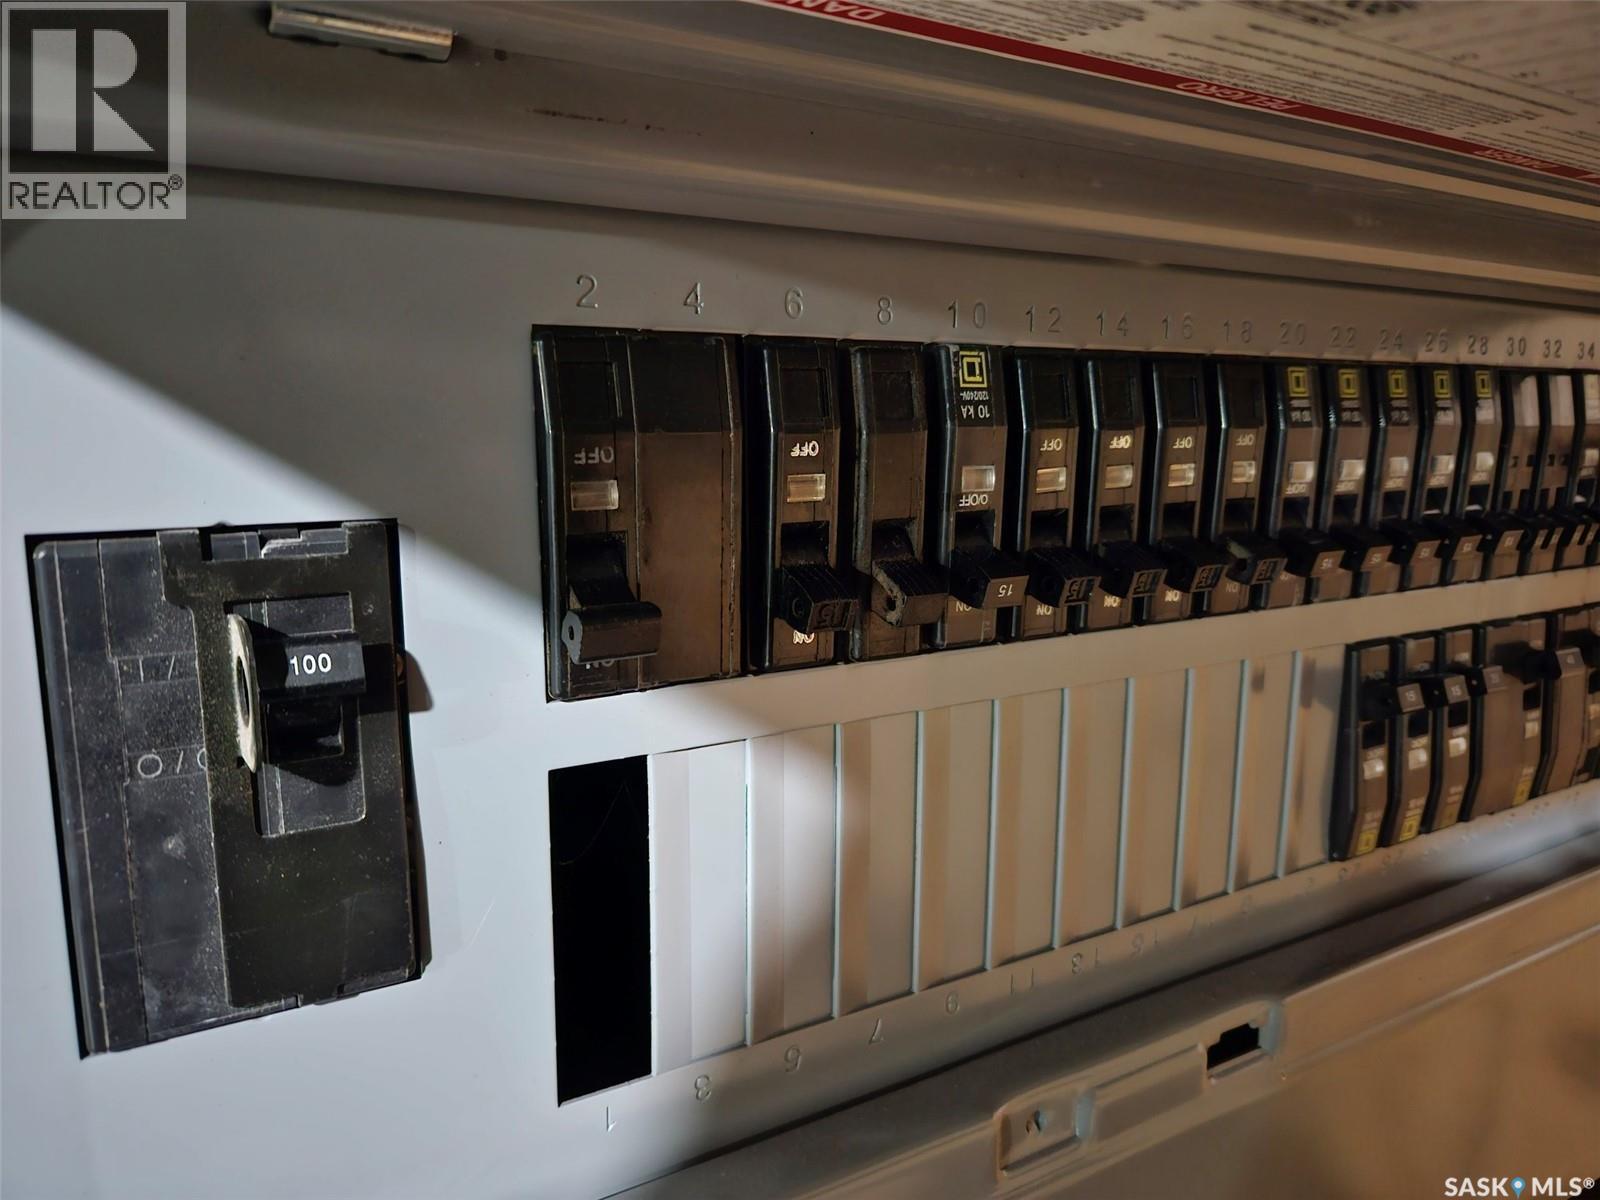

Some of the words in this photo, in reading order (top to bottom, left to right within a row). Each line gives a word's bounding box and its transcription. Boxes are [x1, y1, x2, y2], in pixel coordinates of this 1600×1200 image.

[1176, 81, 1302, 111] PELIGRO
[576, 274, 599, 309] 2
[683, 281, 705, 316] 4
[784, 287, 804, 320] 6
[876, 295, 894, 326] 8
[947, 299, 988, 330] 10
[1024, 305, 1062, 334] 12
[1096, 312, 1130, 338] 14
[1161, 314, 1194, 340] 16
[1223, 318, 1253, 344] 18
[1279, 320, 1307, 346] 20
[1329, 325, 1357, 350] 22
[1378, 328, 1404, 352] 24
[1424, 330, 1449, 353] 26
[1467, 335, 1489, 356] 28
[1505, 336, 1527, 356] 30
[1543, 338, 1562, 359] 32
[1577, 341, 1596, 361] 34
[960, 404, 975, 419] kA
[977, 404, 991, 419] 10
[790, 440, 819, 457] OFF
[1040, 438, 1063, 451] OFF
[1109, 434, 1132, 449] OFF
[1173, 436, 1193, 449] OFF
[574, 446, 615, 465] OFF
[997, 584, 1014, 598] 15
[1165, 589, 1182, 603] ON
[1036, 604, 1053, 616] ON
[1103, 594, 1121, 608] ON
[288, 653, 333, 675] 100
[1071, 946, 1099, 975] 13
[1010, 967, 1035, 995] 11
[867, 1017, 885, 1044] 7
[784, 1045, 802, 1072] 5
[694, 1074, 712, 1102] 3
[605, 1106, 617, 1132] 1
